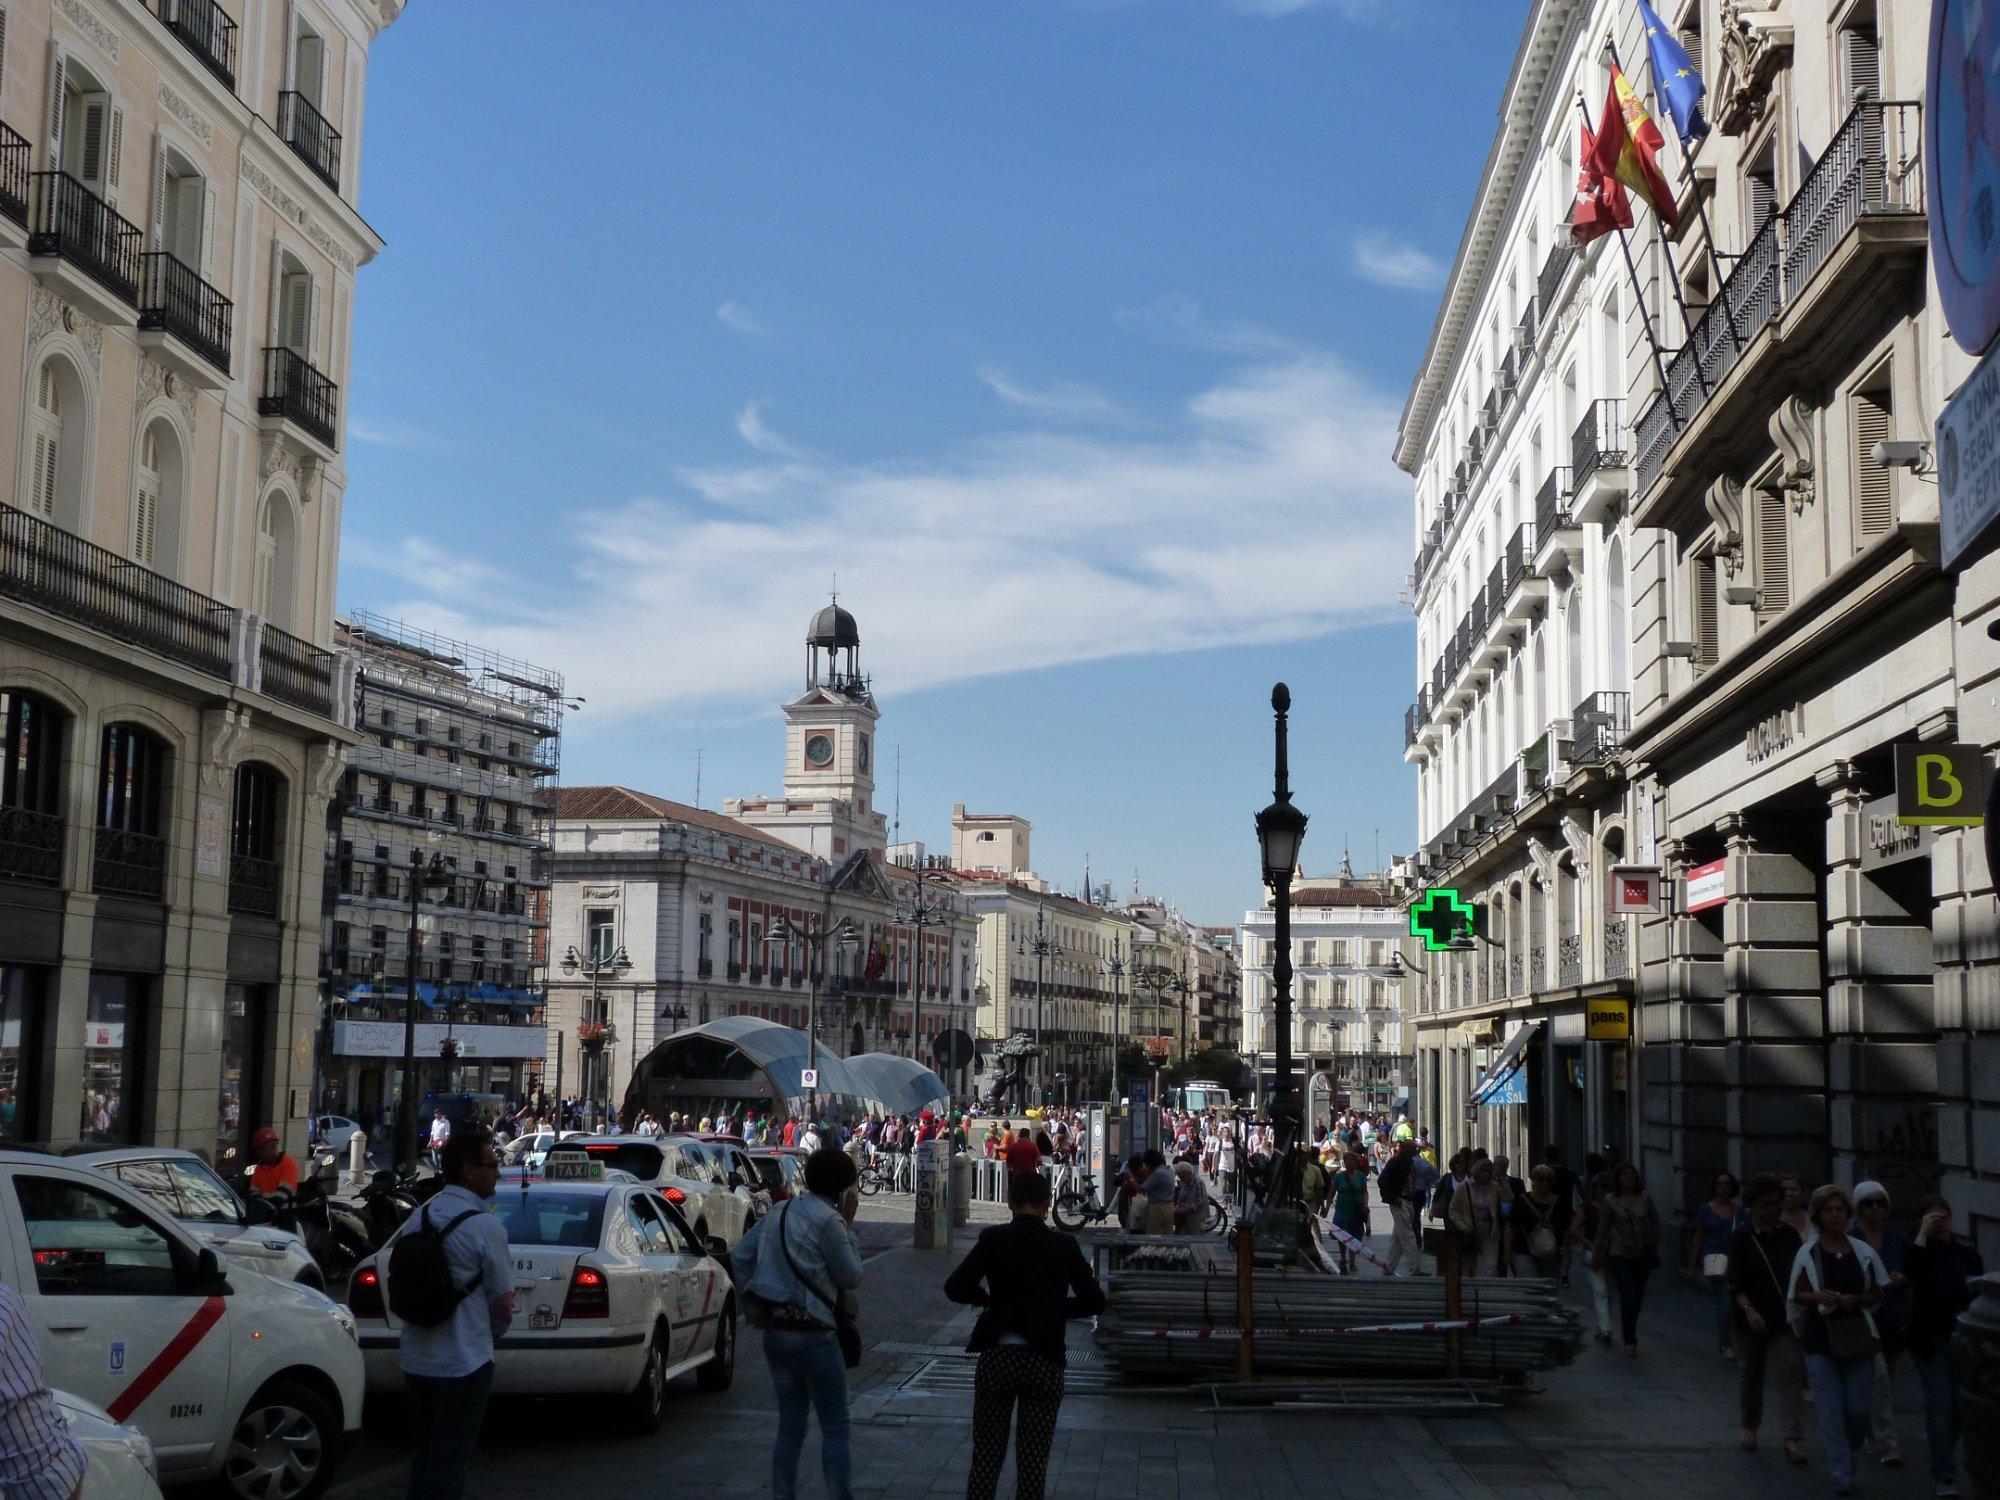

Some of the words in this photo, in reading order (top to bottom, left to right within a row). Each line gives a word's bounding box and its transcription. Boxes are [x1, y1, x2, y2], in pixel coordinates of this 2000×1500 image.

[1954, 456, 2000, 536] EXCEPT
[1916, 753, 1963, 807] B
[1591, 1011, 1625, 1026] pans
[349, 1023, 402, 1042] TOPSHOP
[558, 1163, 588, 1177] TAXI
[511, 1259, 533, 1271] 63
[532, 1315, 554, 1327] SP
[170, 1403, 203, 1418] 08244
